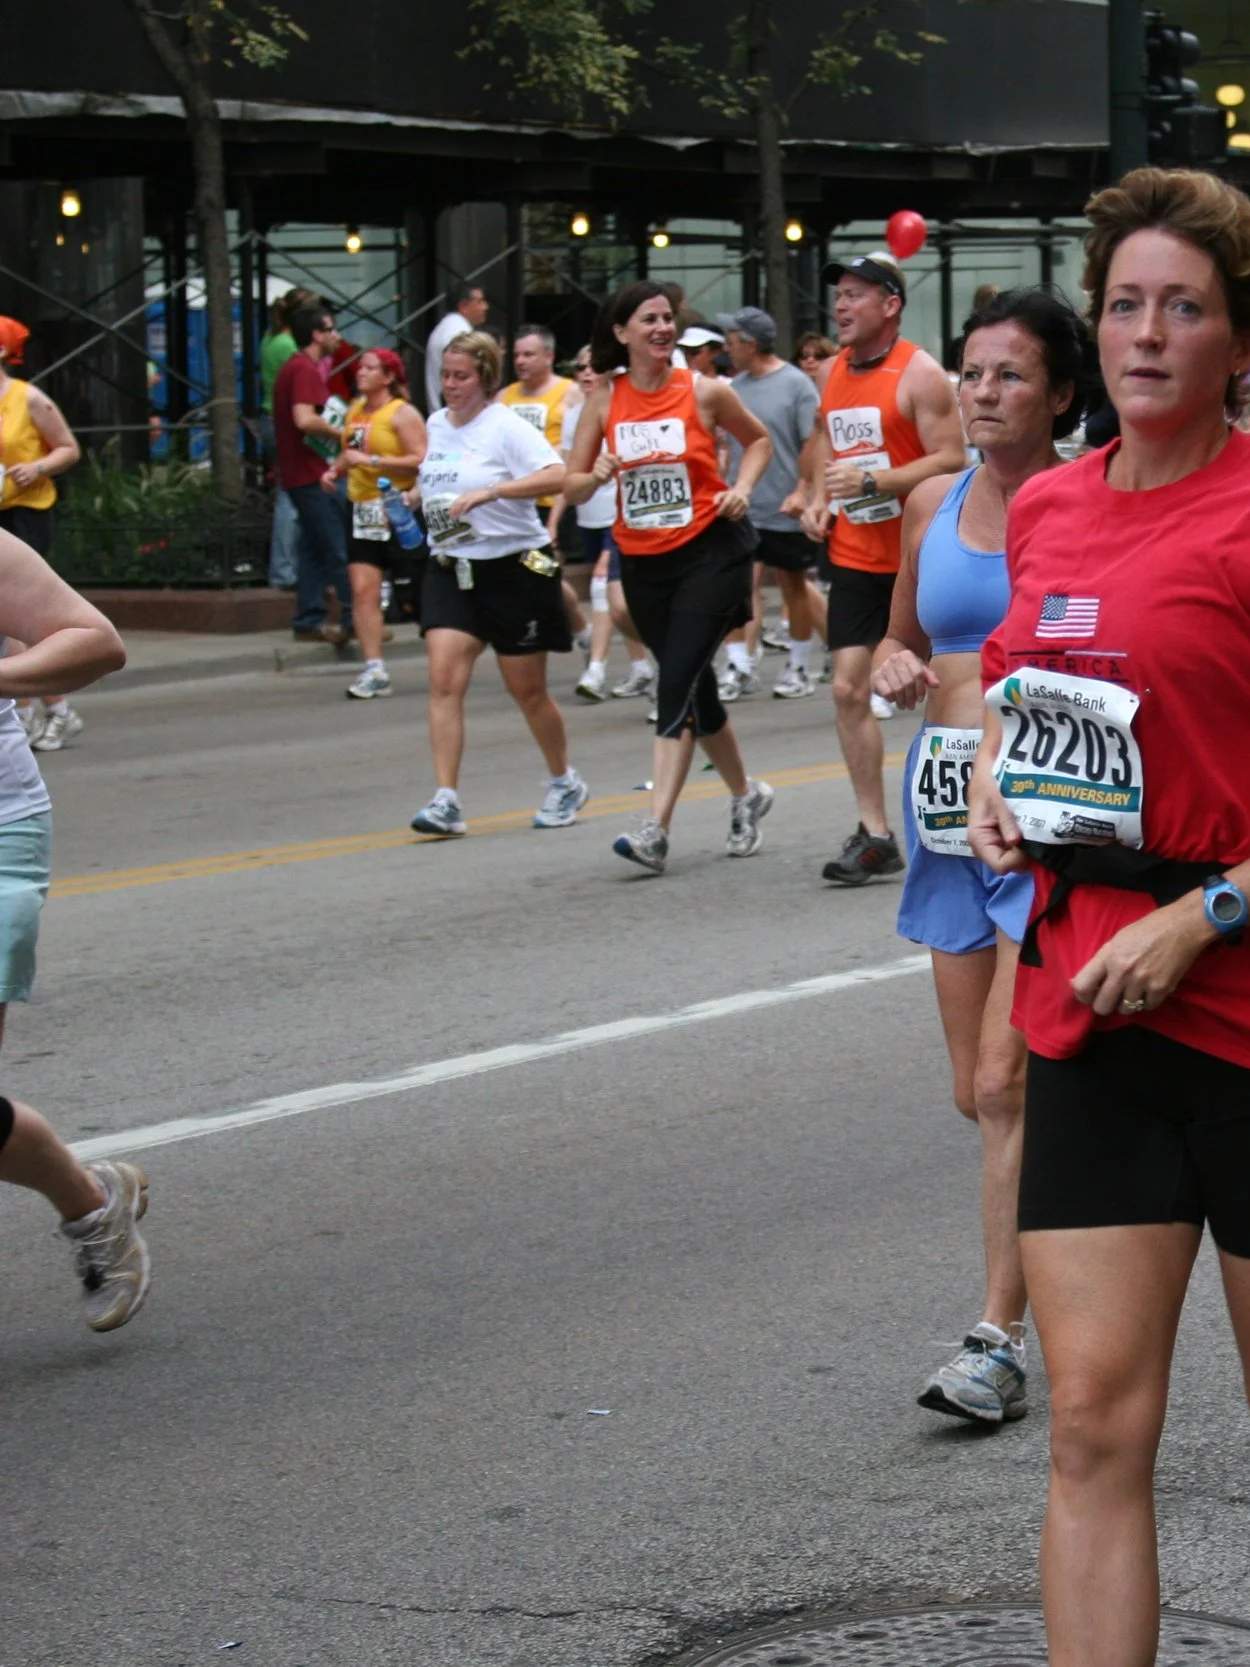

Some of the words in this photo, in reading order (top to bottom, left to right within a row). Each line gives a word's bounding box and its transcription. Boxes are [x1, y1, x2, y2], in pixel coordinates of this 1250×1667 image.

[833, 416, 873, 444] Ross
[625, 478, 687, 505] 24883
[1026, 683, 1071, 703] LaSalle
[1073, 692, 1106, 712] Bank
[1001, 706, 1132, 788] 26203
[1010, 779, 1035, 793] 30th
[1037, 783, 1131, 806] ANNIVERSARY
